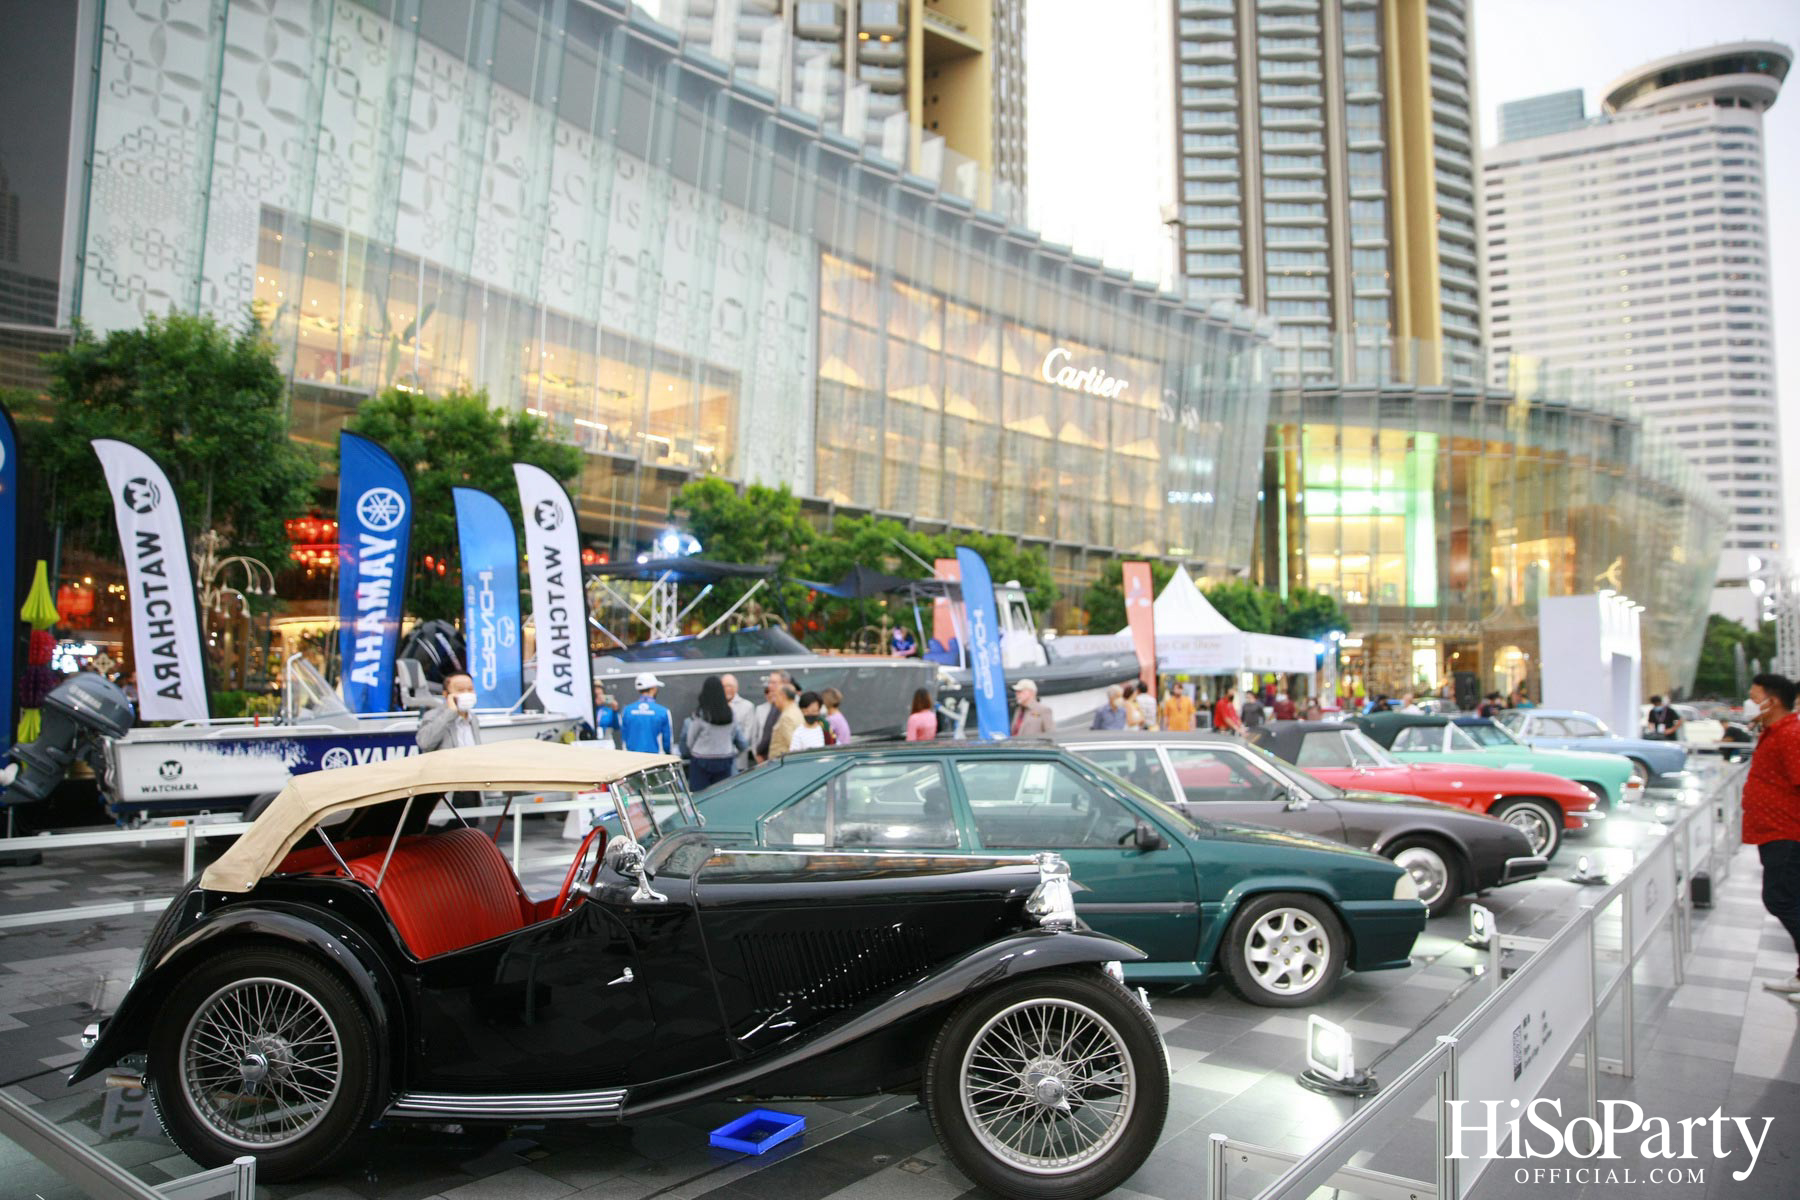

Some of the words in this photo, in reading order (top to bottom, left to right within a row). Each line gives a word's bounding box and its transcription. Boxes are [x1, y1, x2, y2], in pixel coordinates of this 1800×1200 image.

[1042, 347, 1129, 398] Cartier
[354, 745, 420, 766] YAMA
[141, 782, 199, 794] WATCHARA
